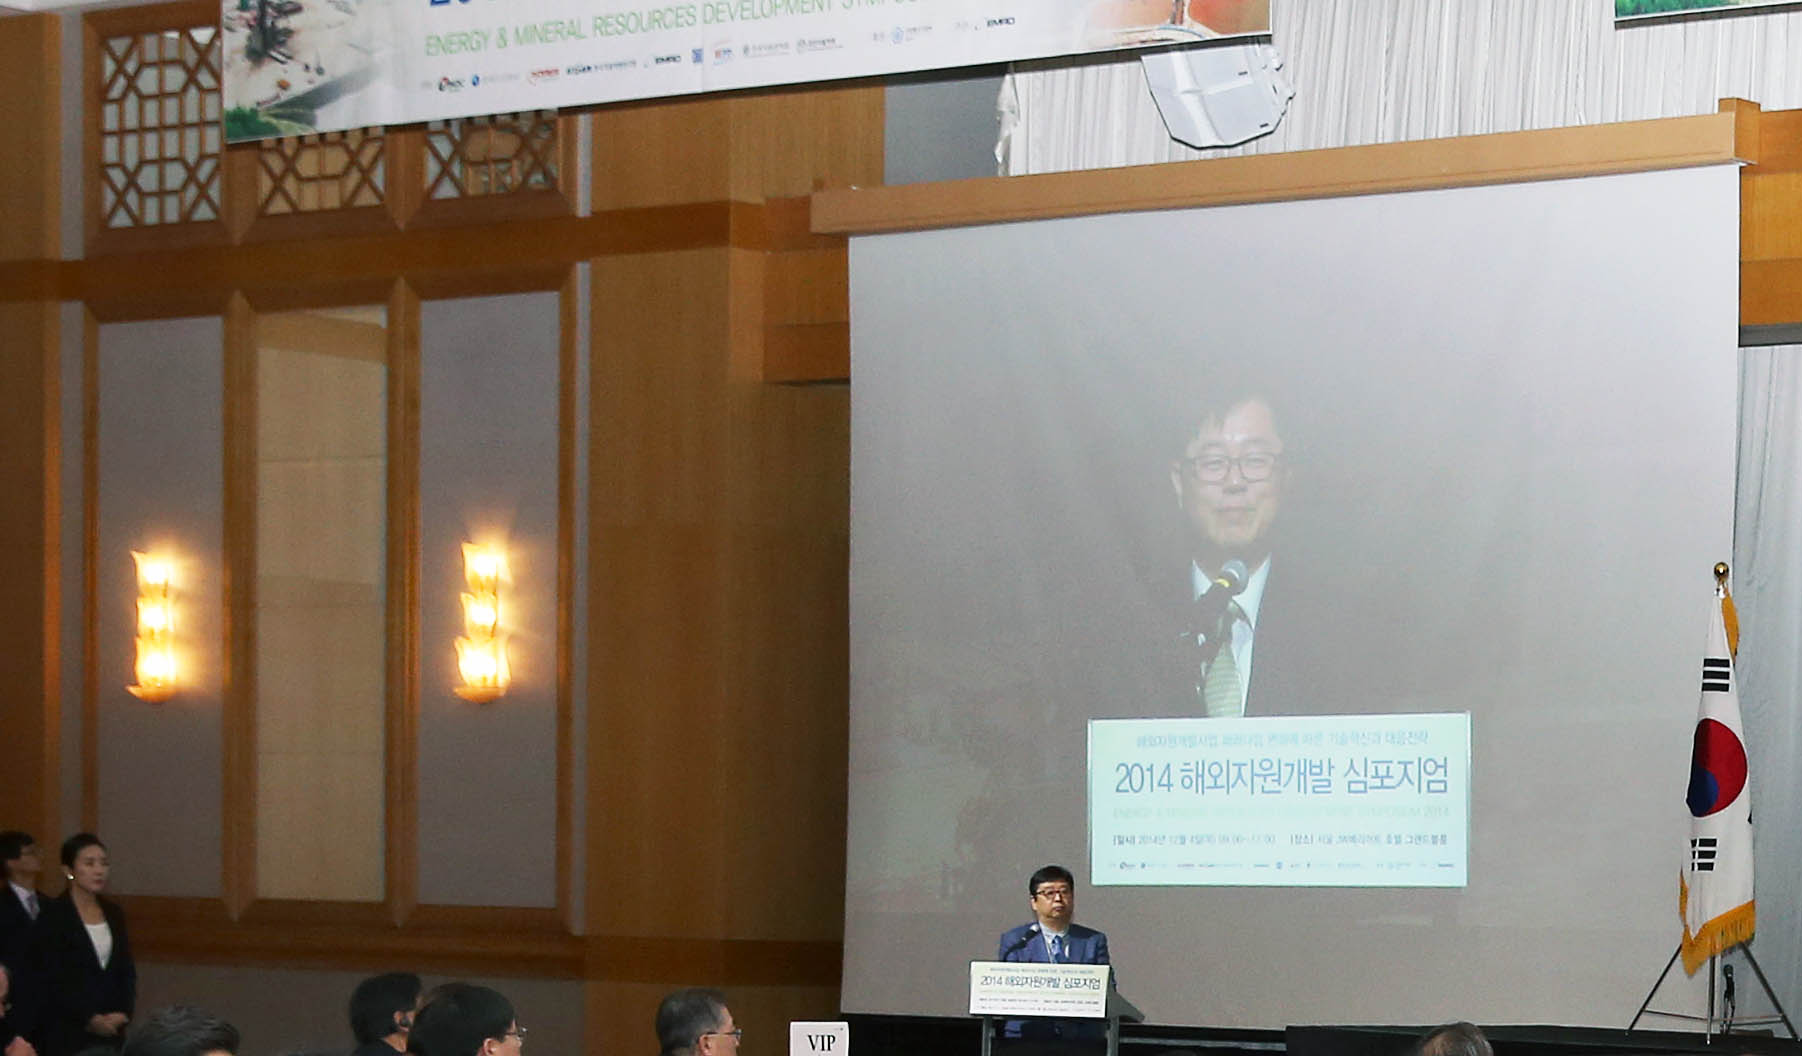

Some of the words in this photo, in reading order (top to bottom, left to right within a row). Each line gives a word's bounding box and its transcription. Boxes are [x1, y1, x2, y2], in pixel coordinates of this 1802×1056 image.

[425, 31, 491, 57] ENERGY
[514, 16, 588, 47] MINERAL
[593, 5, 698, 37] RESOURCES
[1115, 762, 1174, 794] 2014
[1343, 756, 1449, 795] 심포지엄
[807, 1034, 836, 1052] VIP
